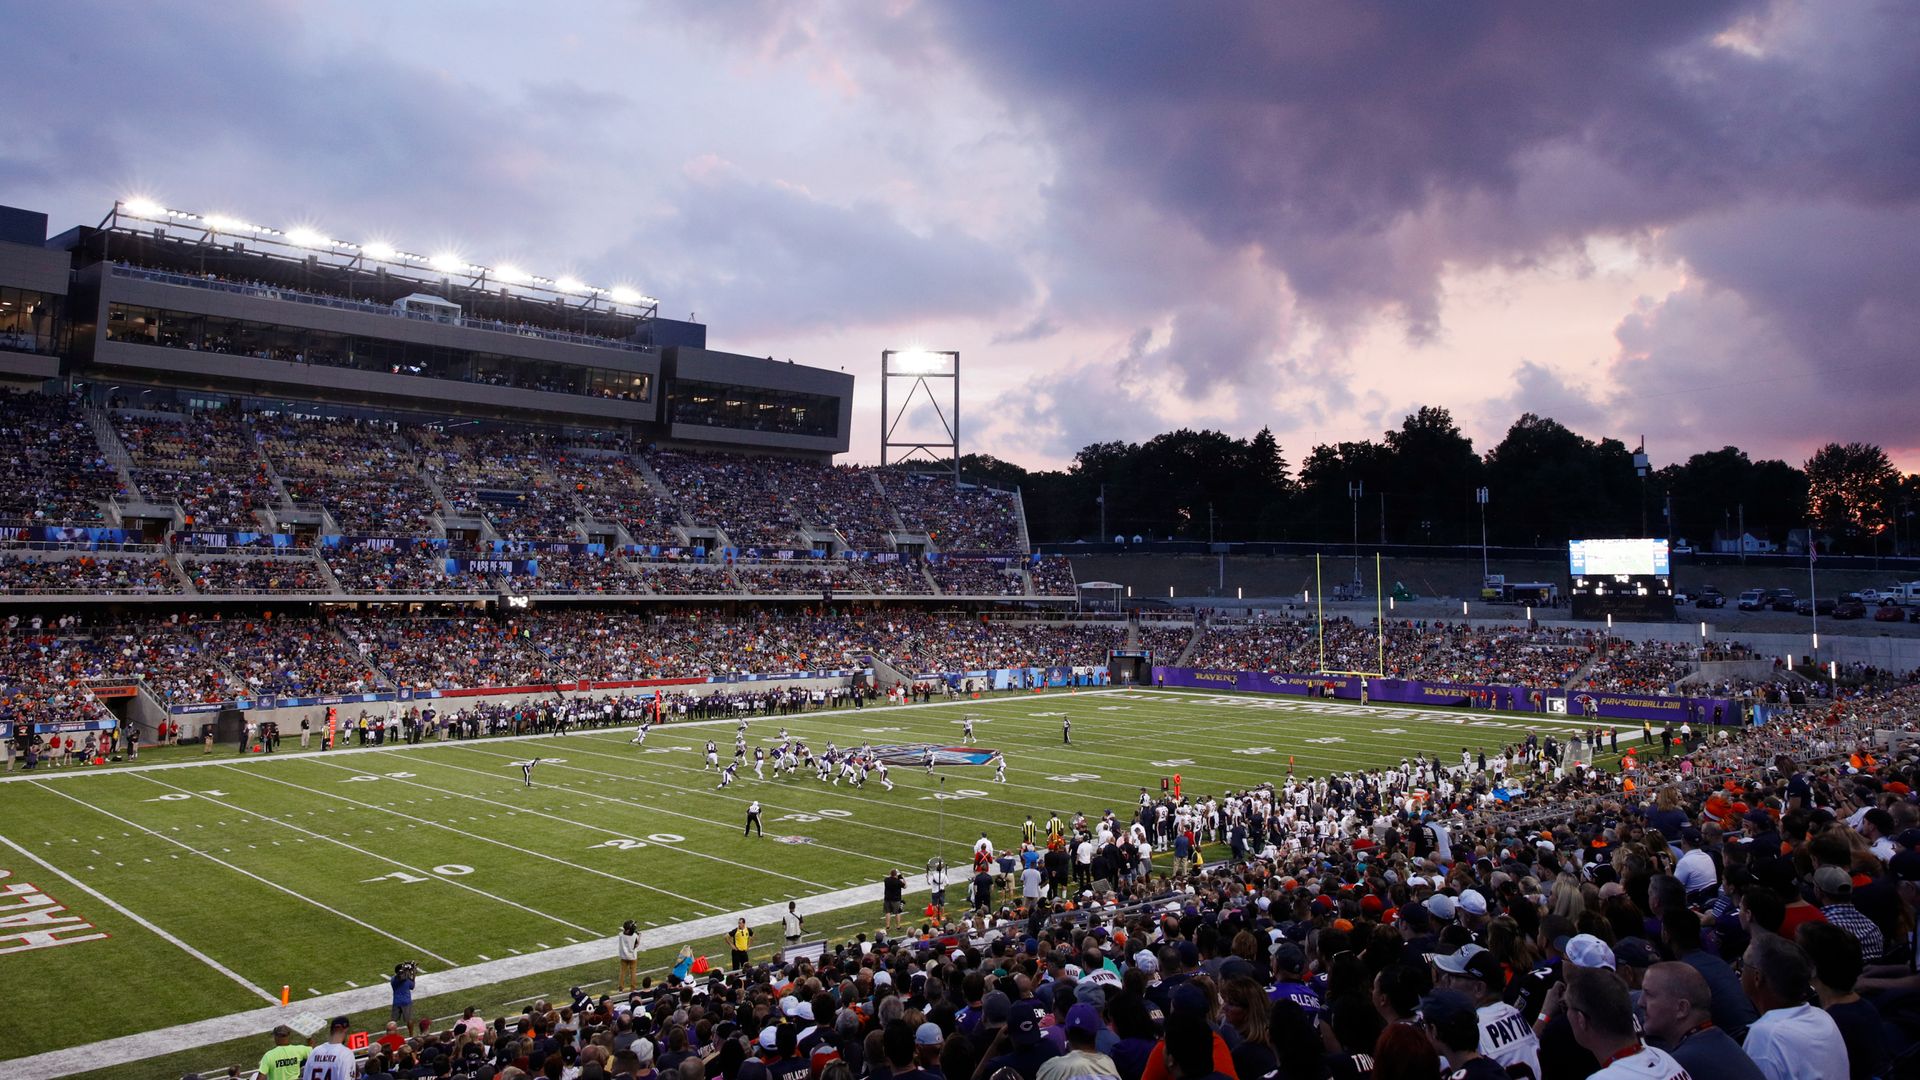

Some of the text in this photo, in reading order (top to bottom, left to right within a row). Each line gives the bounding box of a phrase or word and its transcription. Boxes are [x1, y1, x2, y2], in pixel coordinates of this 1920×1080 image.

[470, 560, 489, 572] CLASS
[1424, 687, 1472, 697] RAVEN
[604, 833, 686, 850] 20
[386, 864, 475, 884] 10
[1092, 973, 1117, 983] PAYTON
[1486, 1013, 1532, 1048] PAYTO
[275, 1057, 299, 1068] VENDOR
